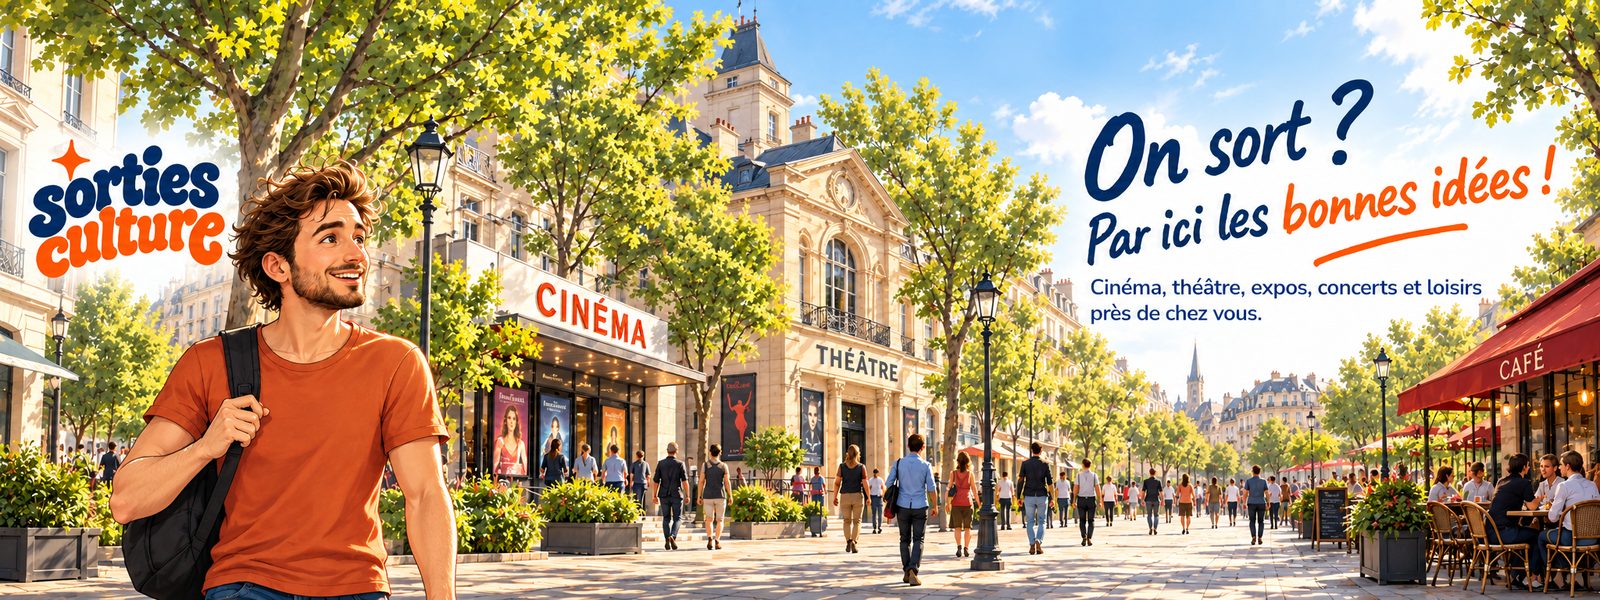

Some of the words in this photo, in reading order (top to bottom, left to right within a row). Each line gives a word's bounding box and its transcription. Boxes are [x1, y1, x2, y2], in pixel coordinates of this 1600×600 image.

[536, 282, 647, 350] CINÉMA
[816, 344, 899, 382] THÉÂTRE
[1499, 343, 1545, 380] CAFÉ
